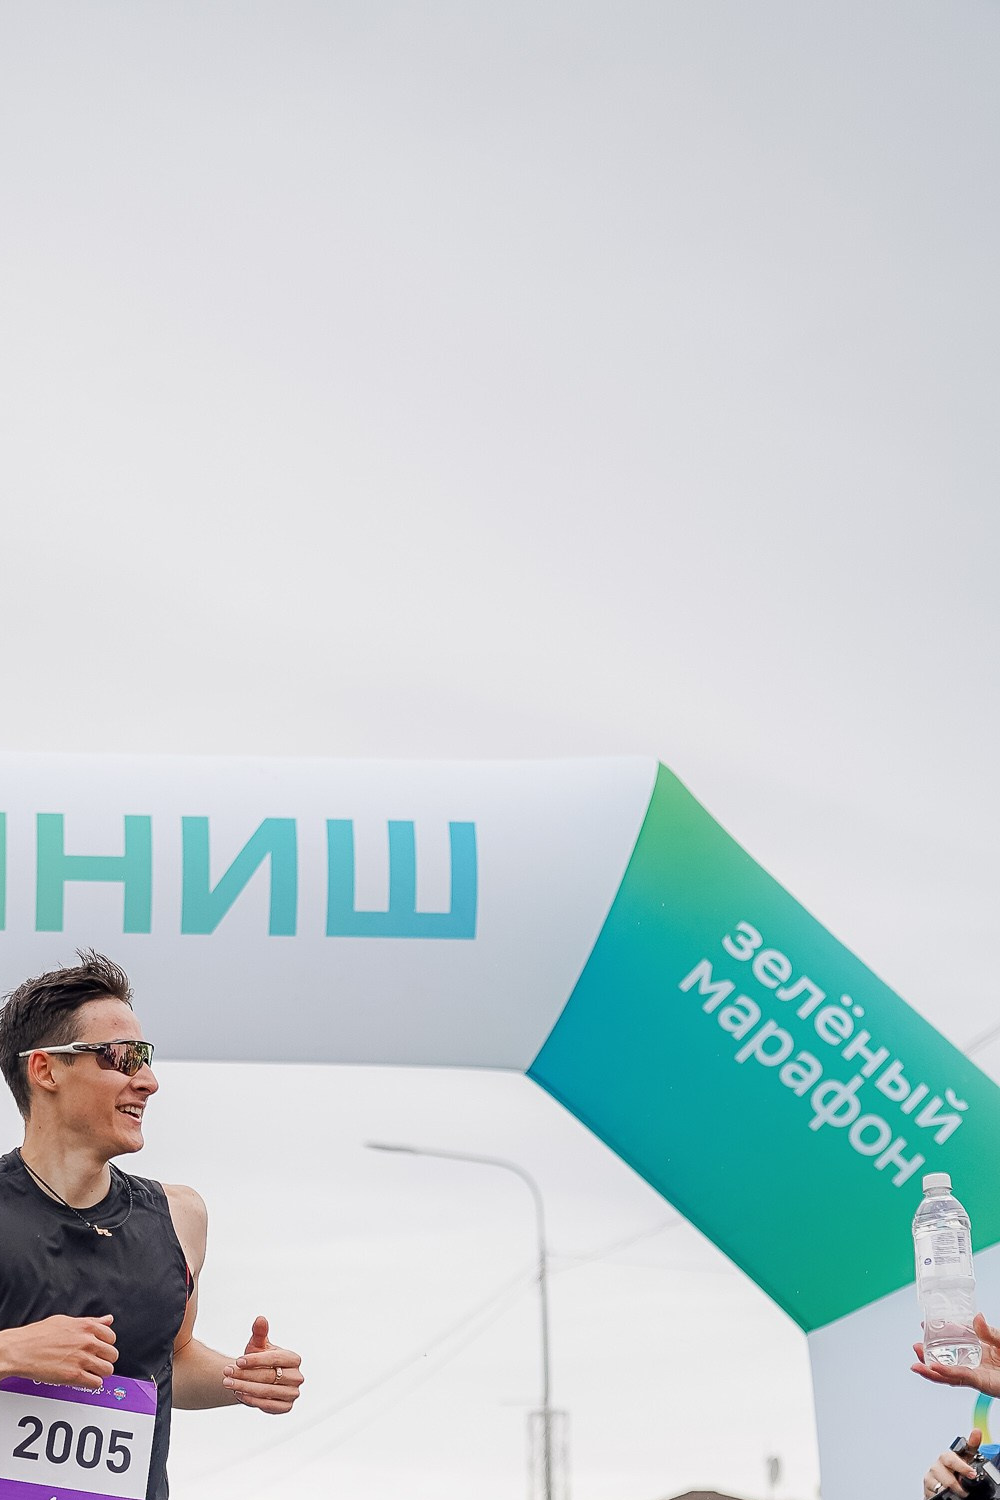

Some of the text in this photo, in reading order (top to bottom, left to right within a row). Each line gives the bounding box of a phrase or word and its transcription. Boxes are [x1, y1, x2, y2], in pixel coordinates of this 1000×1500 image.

[678, 958, 926, 1187] марафон
[721, 920, 969, 1145] зелёный
[12, 1415, 134, 1474] 2005
